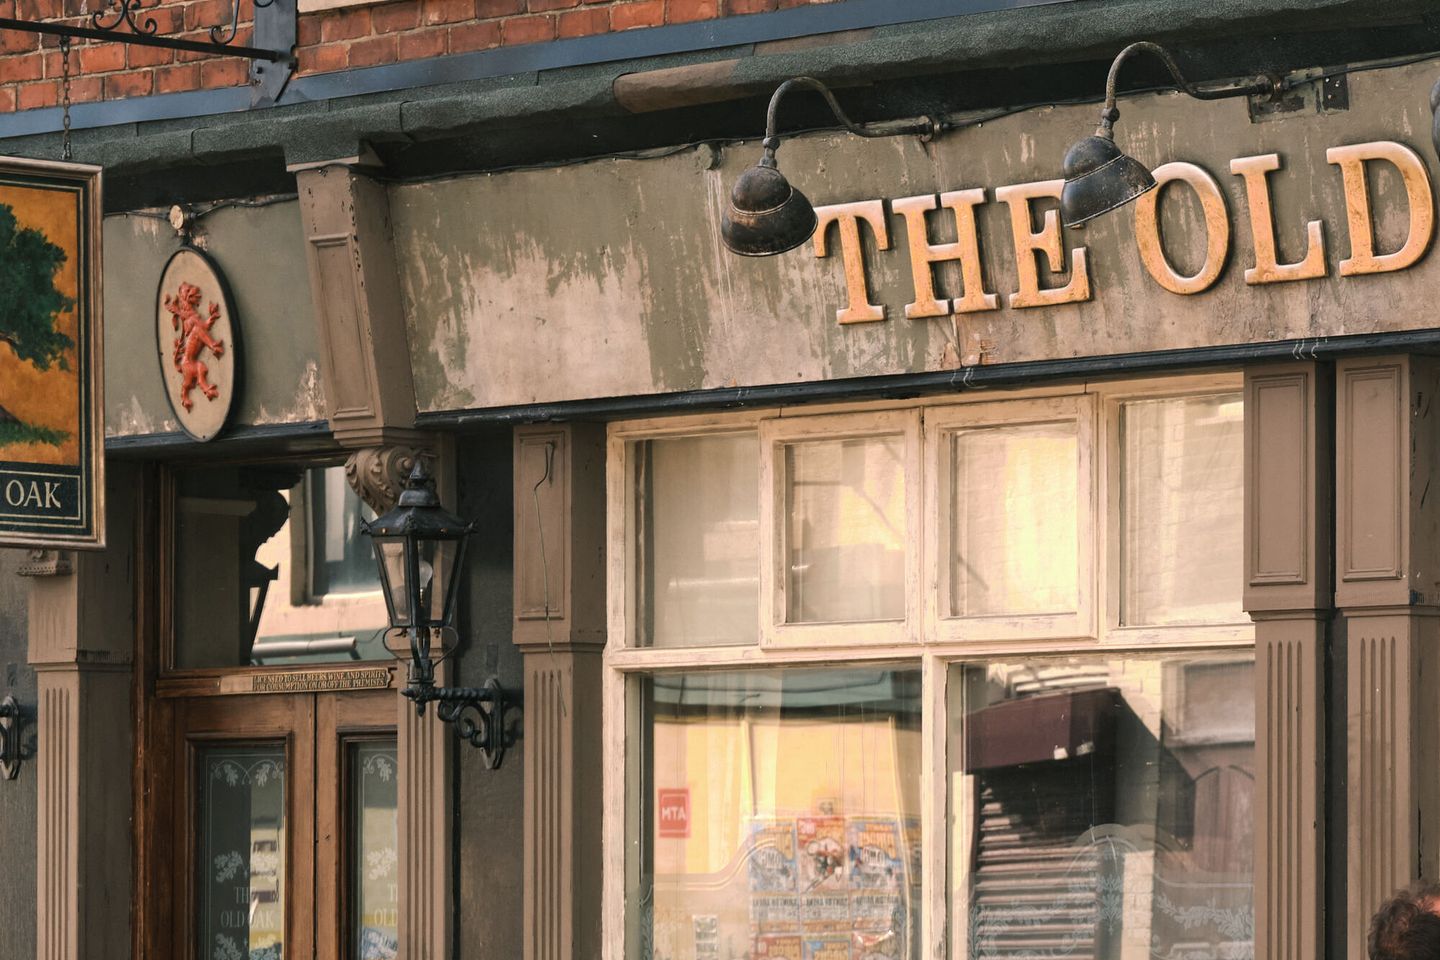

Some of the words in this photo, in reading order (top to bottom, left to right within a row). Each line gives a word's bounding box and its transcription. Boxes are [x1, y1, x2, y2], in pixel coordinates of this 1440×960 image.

[813, 179, 1091, 325] THE
[1134, 140, 1433, 295] OLD
[6, 479, 62, 508] OAK
[220, 911, 245, 928] OLD
